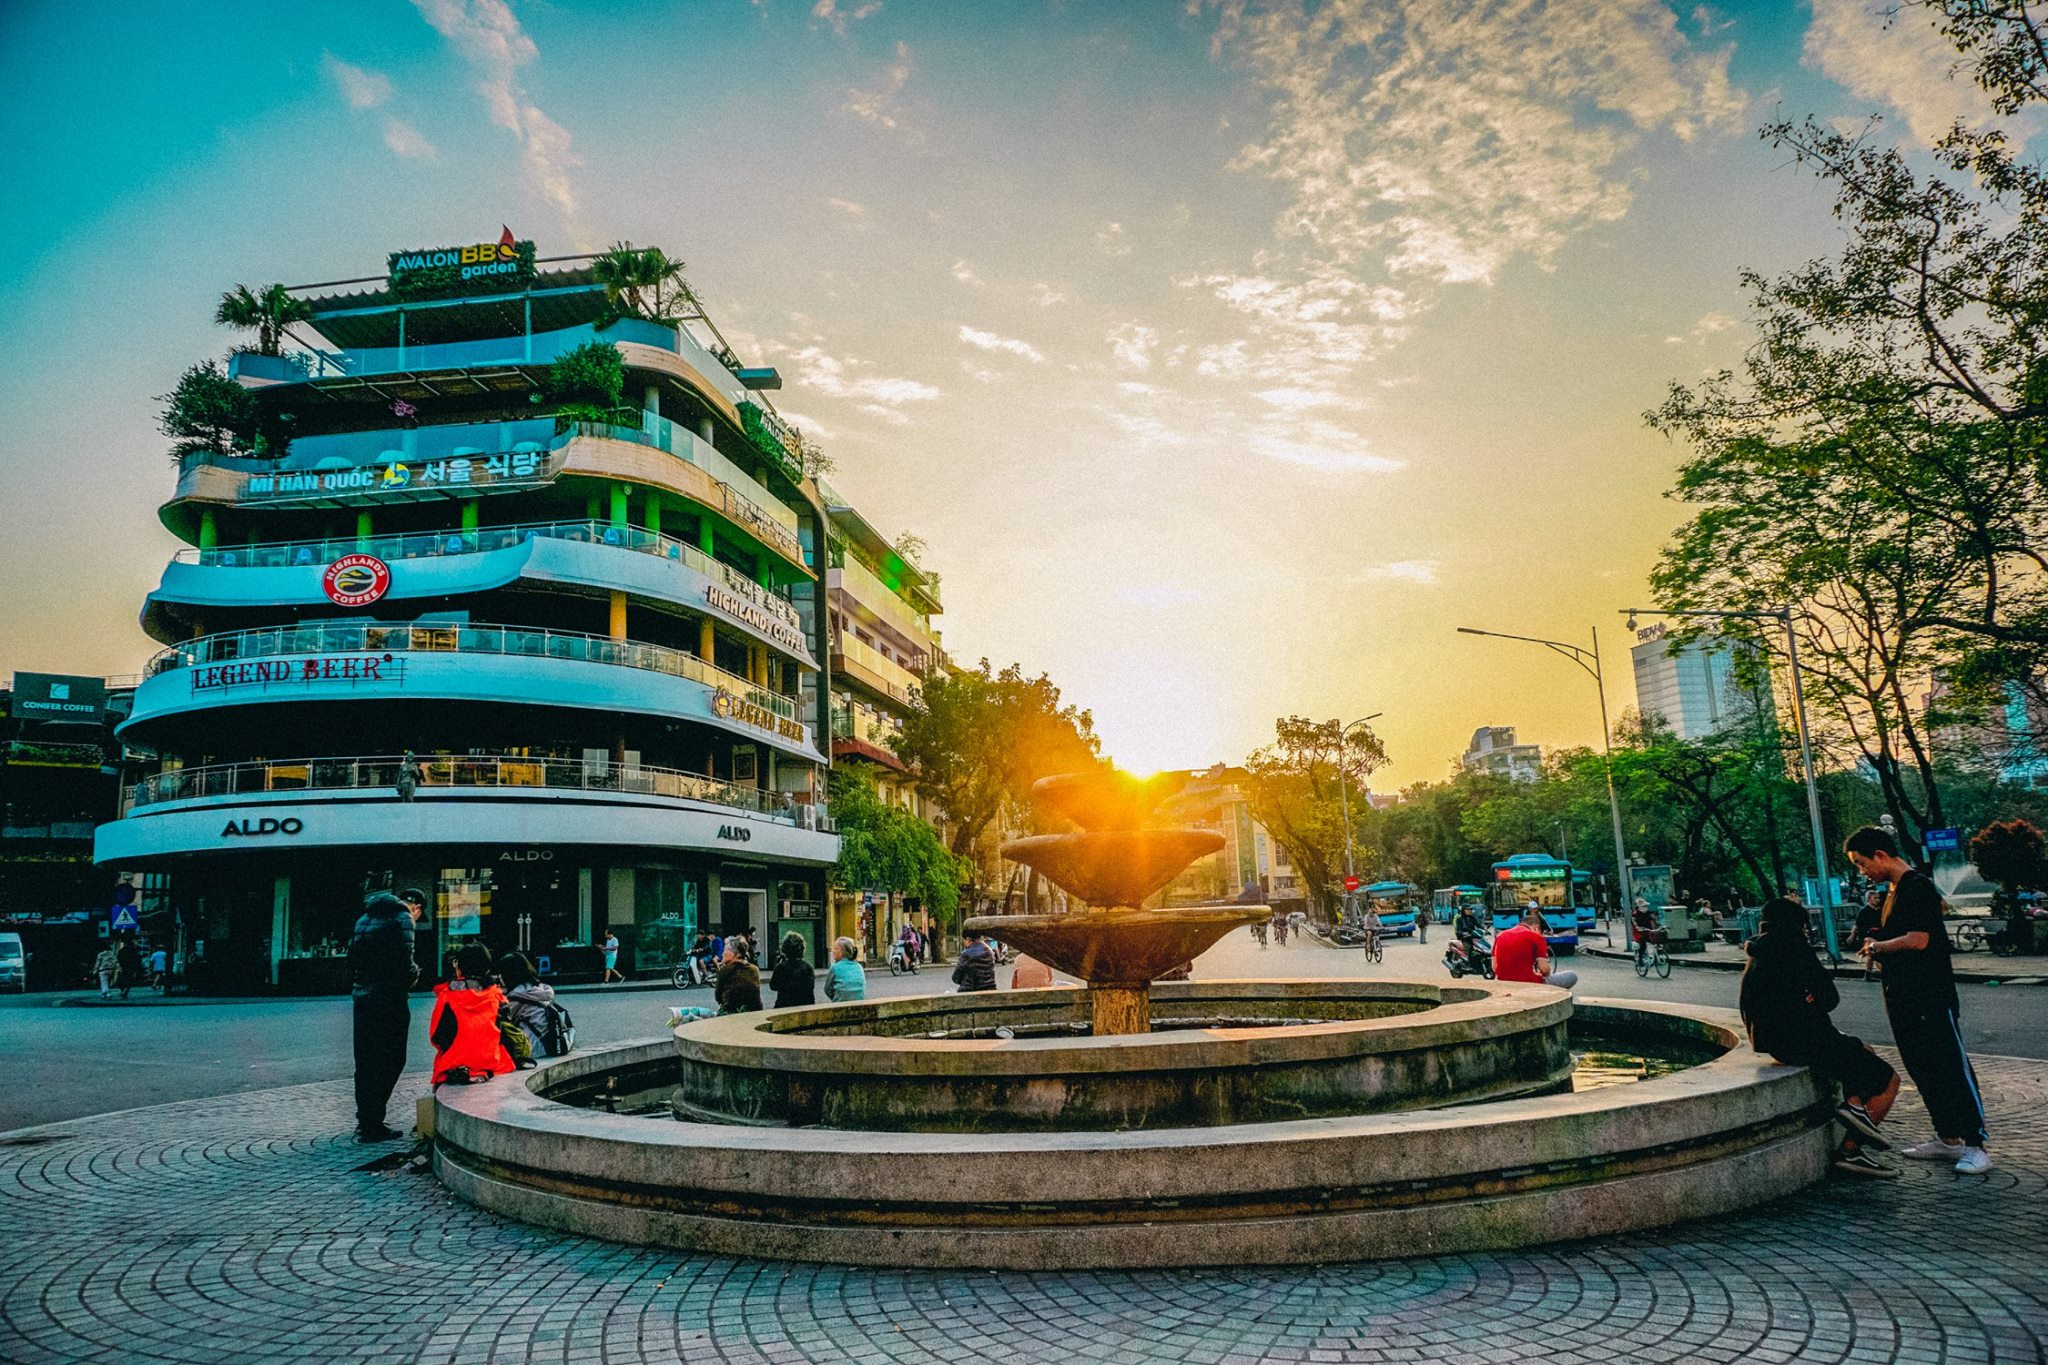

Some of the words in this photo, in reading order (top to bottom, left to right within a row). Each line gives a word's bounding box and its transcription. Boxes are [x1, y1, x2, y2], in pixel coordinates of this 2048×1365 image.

[396, 252, 459, 271] AVALON
[461, 241, 520, 264] BBQ
[461, 262, 517, 279] garden
[420, 459, 474, 482] 서울
[481, 452, 541, 478] 식당
[326, 557, 386, 581] HIGHLANDS
[333, 589, 379, 604] COFFEE
[708, 586, 772, 633] HIGHLANDS
[194, 660, 291, 689] LEGEND
[302, 657, 383, 681] BEER
[23, 701, 62, 710] CONIFER
[63, 703, 95, 713] COFFEE
[220, 817, 304, 837] ALDO
[717, 824, 752, 842] ALDO
[499, 850, 554, 861] ALDO
[661, 911, 680, 920] ALDO
